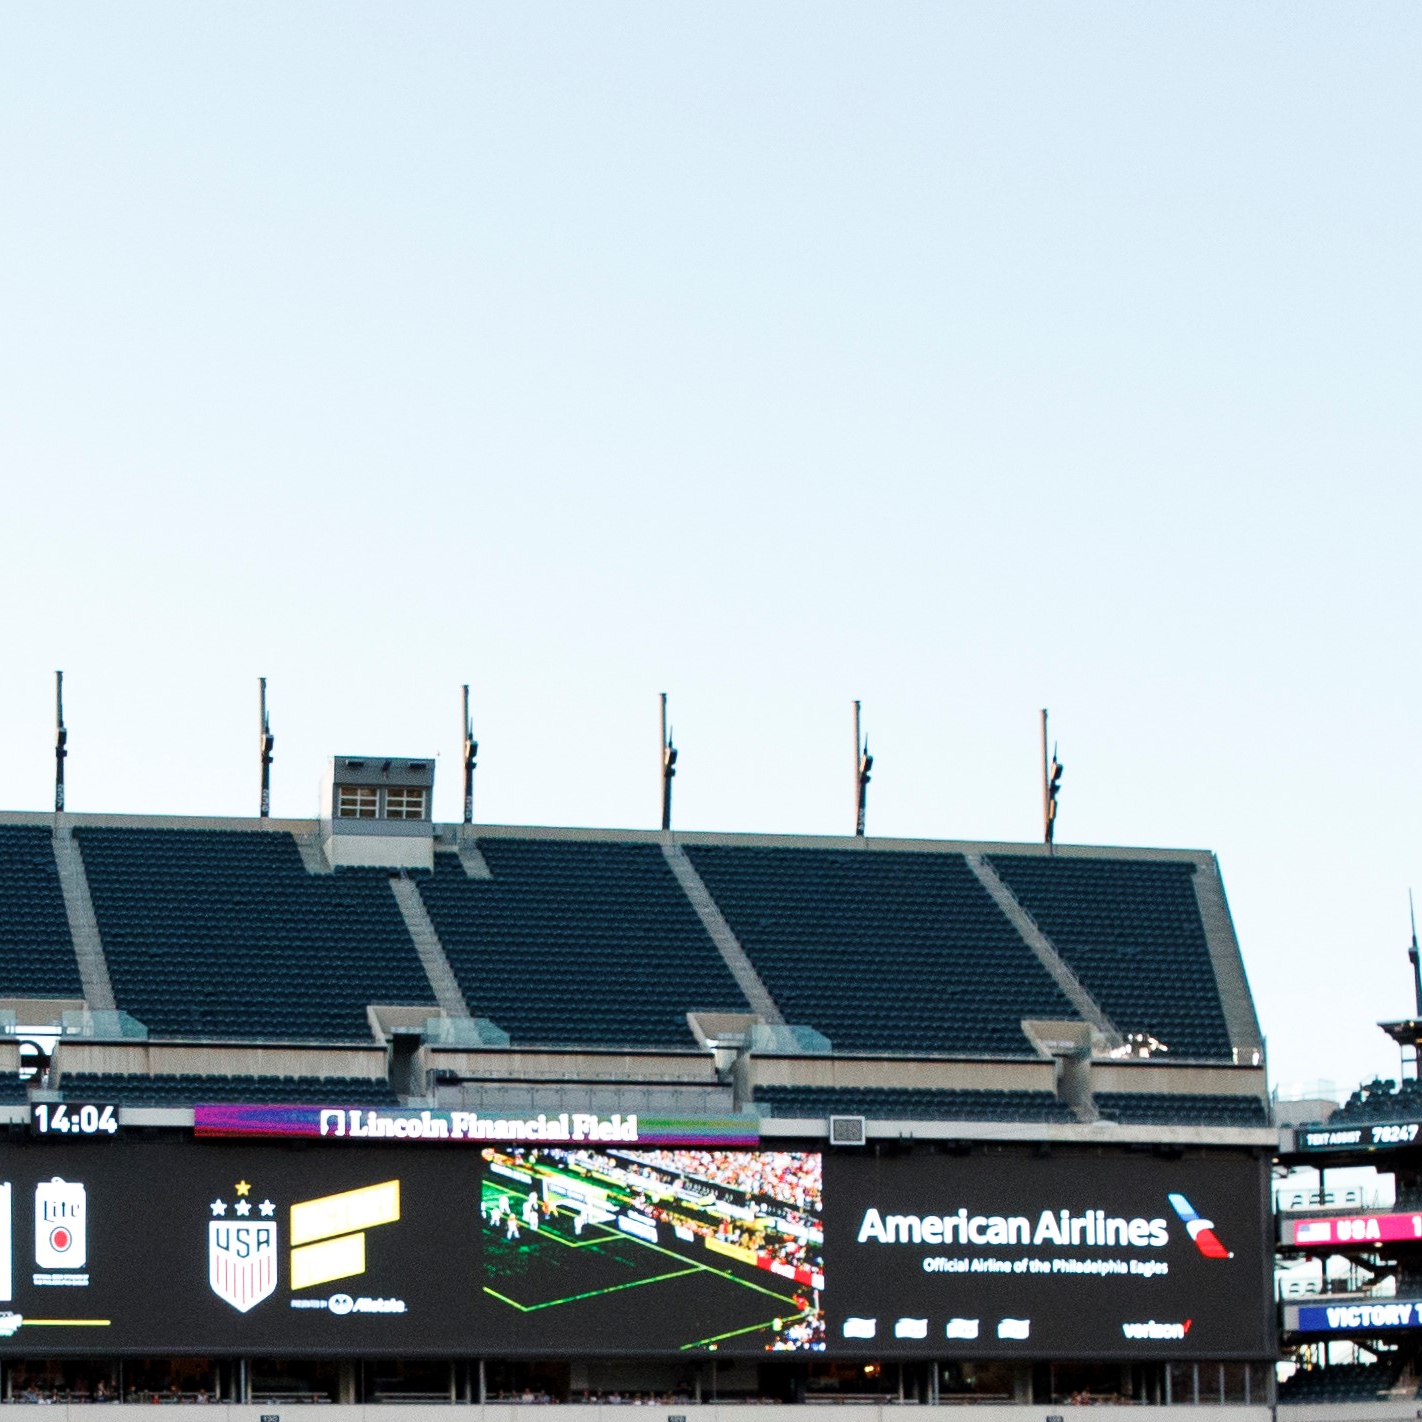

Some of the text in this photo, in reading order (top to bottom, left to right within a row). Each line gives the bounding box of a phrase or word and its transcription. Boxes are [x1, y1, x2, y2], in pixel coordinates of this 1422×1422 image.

[35, 1104, 118, 1134] 14:04
[349, 1109, 639, 1141] Lincoln Financial Field
[1371, 1123, 1420, 1144] 78247
[857, 1208, 1169, 1246] American Airlines
[1336, 1216, 1422, 1240] USA 1
[216, 1228, 270, 1259] USA
[923, 1257, 1169, 1278] Official Airline of the Philadelphia Eagles
[1327, 1302, 1412, 1328] VICTORY
[1122, 1320, 1185, 1340] verizon
